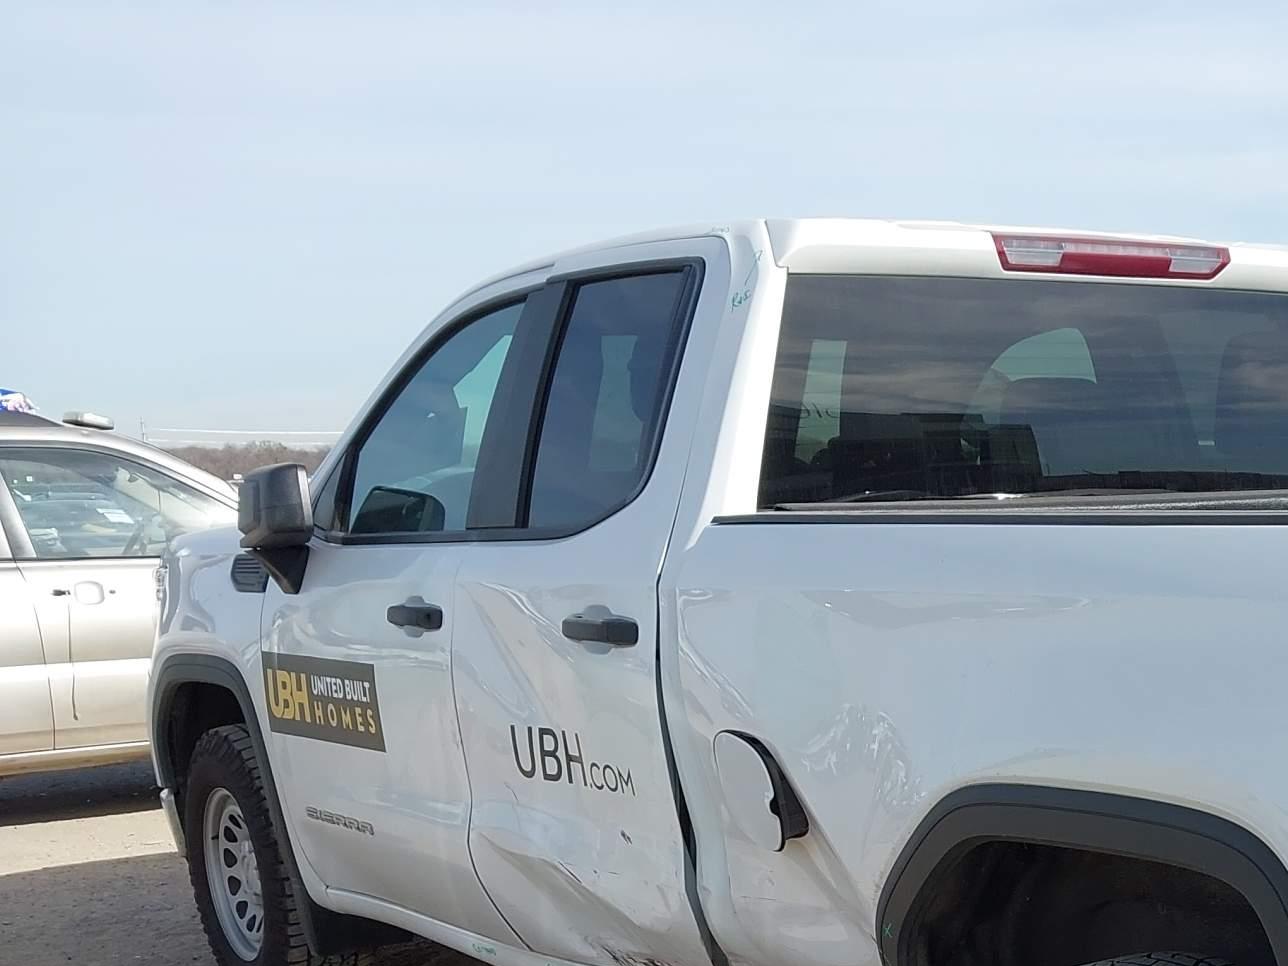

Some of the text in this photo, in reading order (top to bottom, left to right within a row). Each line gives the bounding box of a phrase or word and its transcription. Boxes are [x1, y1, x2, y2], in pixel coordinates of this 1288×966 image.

[266, 668, 312, 723] UBH
[310, 674, 370, 703] UNITED BUILT
[314, 701, 376, 734] HOMES
[510, 724, 636, 796] UBH.COM
[305, 805, 375, 836] SIERRA
